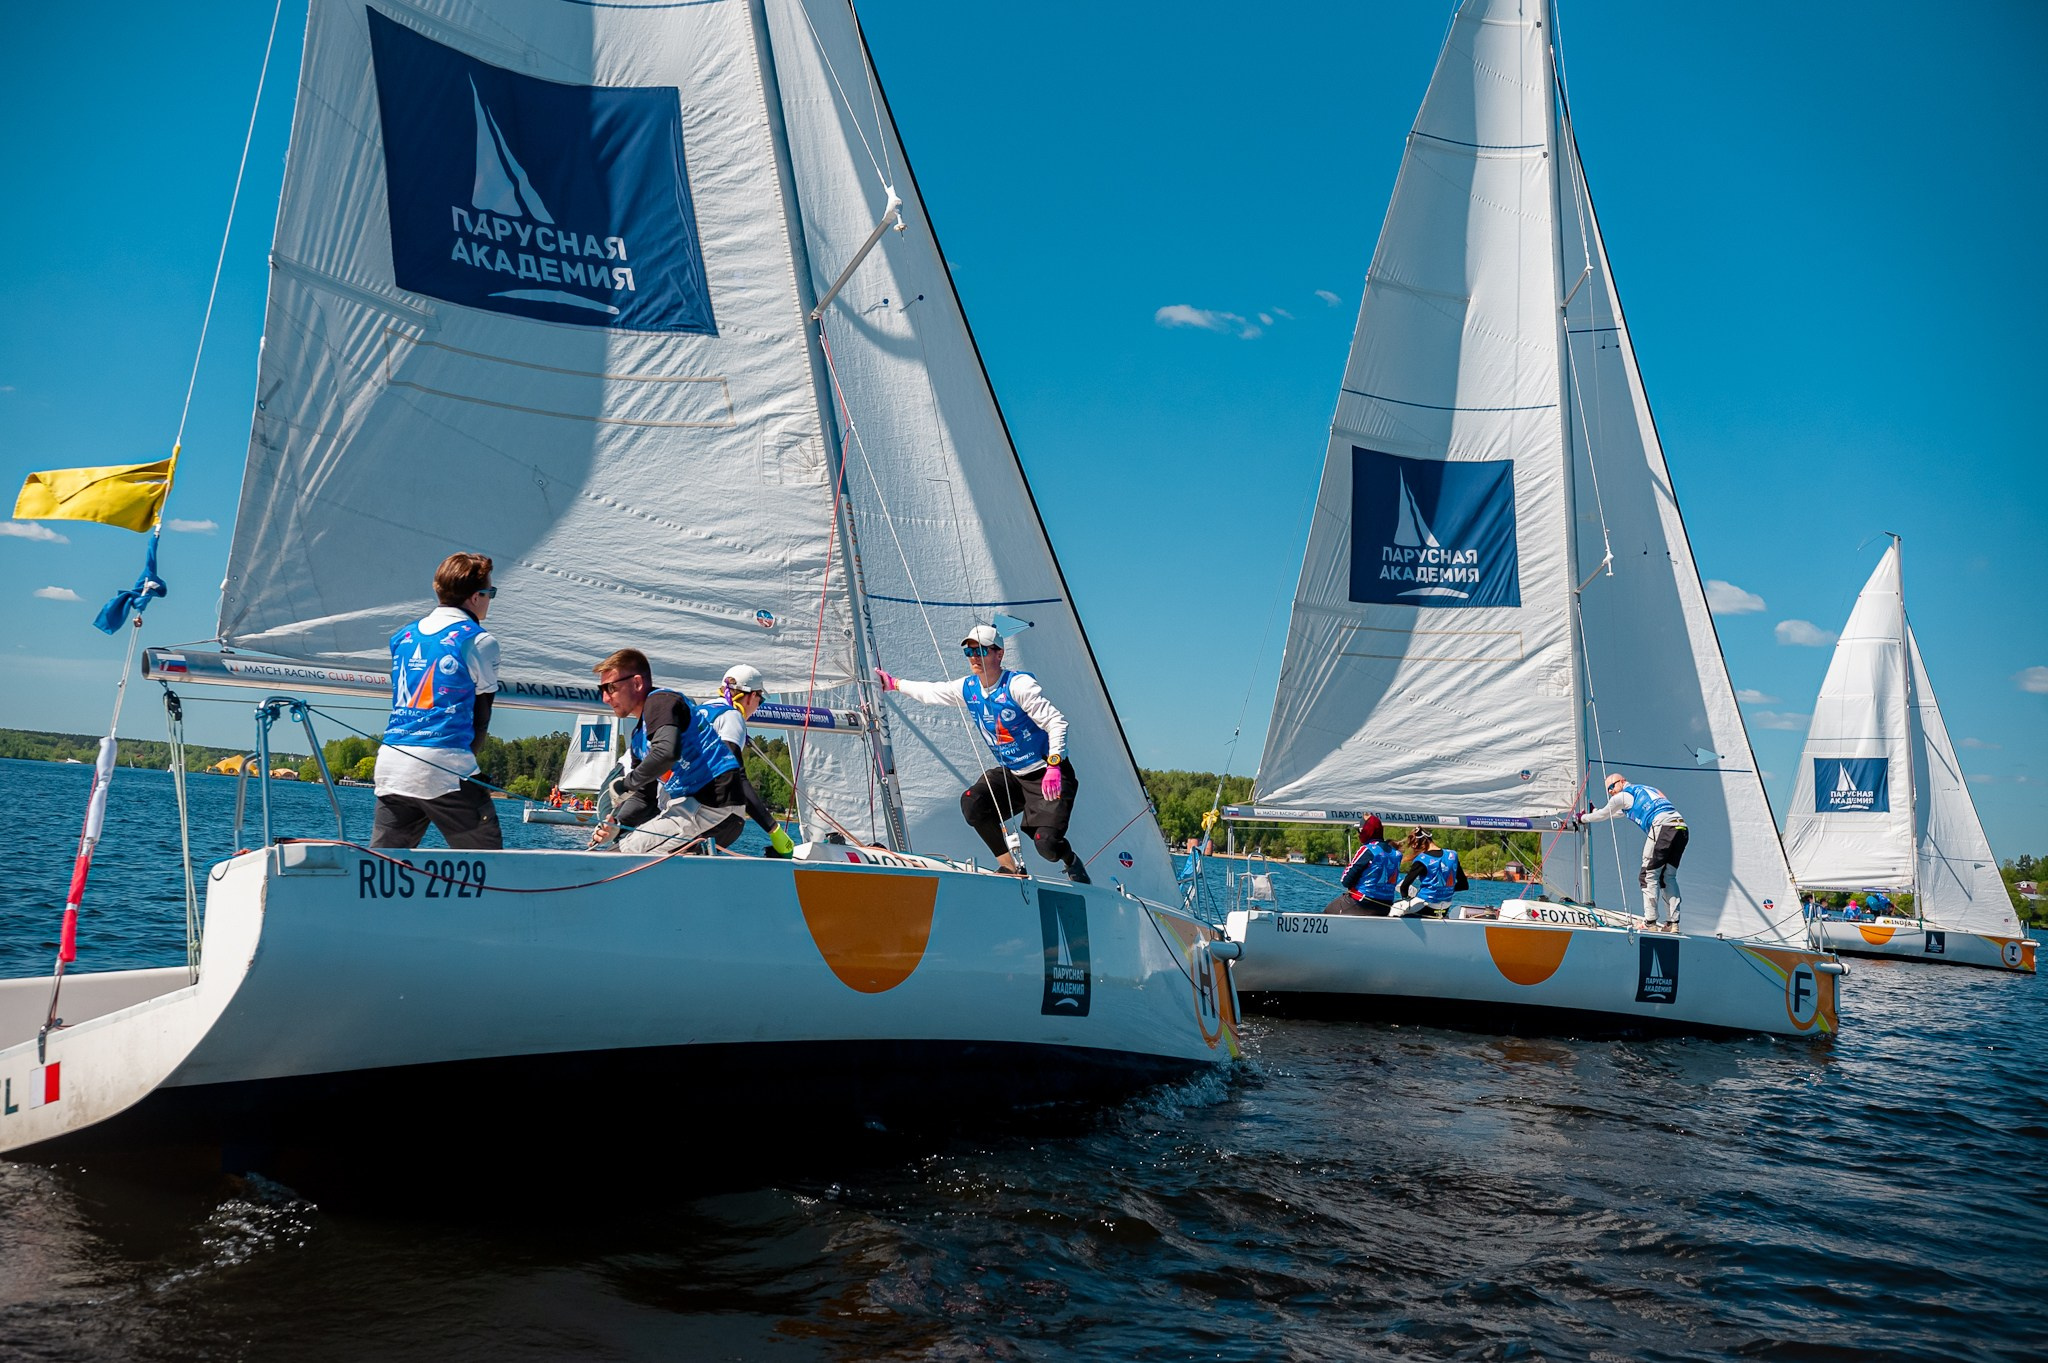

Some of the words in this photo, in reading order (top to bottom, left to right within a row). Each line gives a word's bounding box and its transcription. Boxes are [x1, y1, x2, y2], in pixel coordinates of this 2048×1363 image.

[452, 206, 628, 261] ПАРУСНАЯ
[451, 237, 636, 291] АКАДЕМИЯ
[1382, 546, 1478, 564] ПАРУСНАЯ
[1379, 565, 1480, 583] АКАДЕМИЯ
[244, 665, 282, 676] MATCH
[285, 667, 325, 680] RACING
[328, 671, 355, 682] CLUB
[358, 674, 387, 685] TOUR
[516, 682, 602, 701] АКАДЕМИ
[780, 711, 808, 721] МАТЧЕВЫ
[1331, 810, 1382, 819] ПАРУСЯ
[1385, 813, 1437, 823] АКАДЕМИЯ
[359, 859, 415, 898] RUS
[425, 860, 486, 898] 2929
[1277, 917, 1299, 932] RUS
[1303, 918, 1329, 934] 2926
[1053, 967, 1084, 980] ПАРУСНАЯ
[1197, 946, 1216, 1019] H
[1645, 977, 1672, 986] ПАРУСНАЯ
[1052, 981, 1085, 995] АКАДЕМИЯ
[1644, 985, 1672, 993] АКАДЕМИЯ
[1794, 970, 1812, 1013] F
